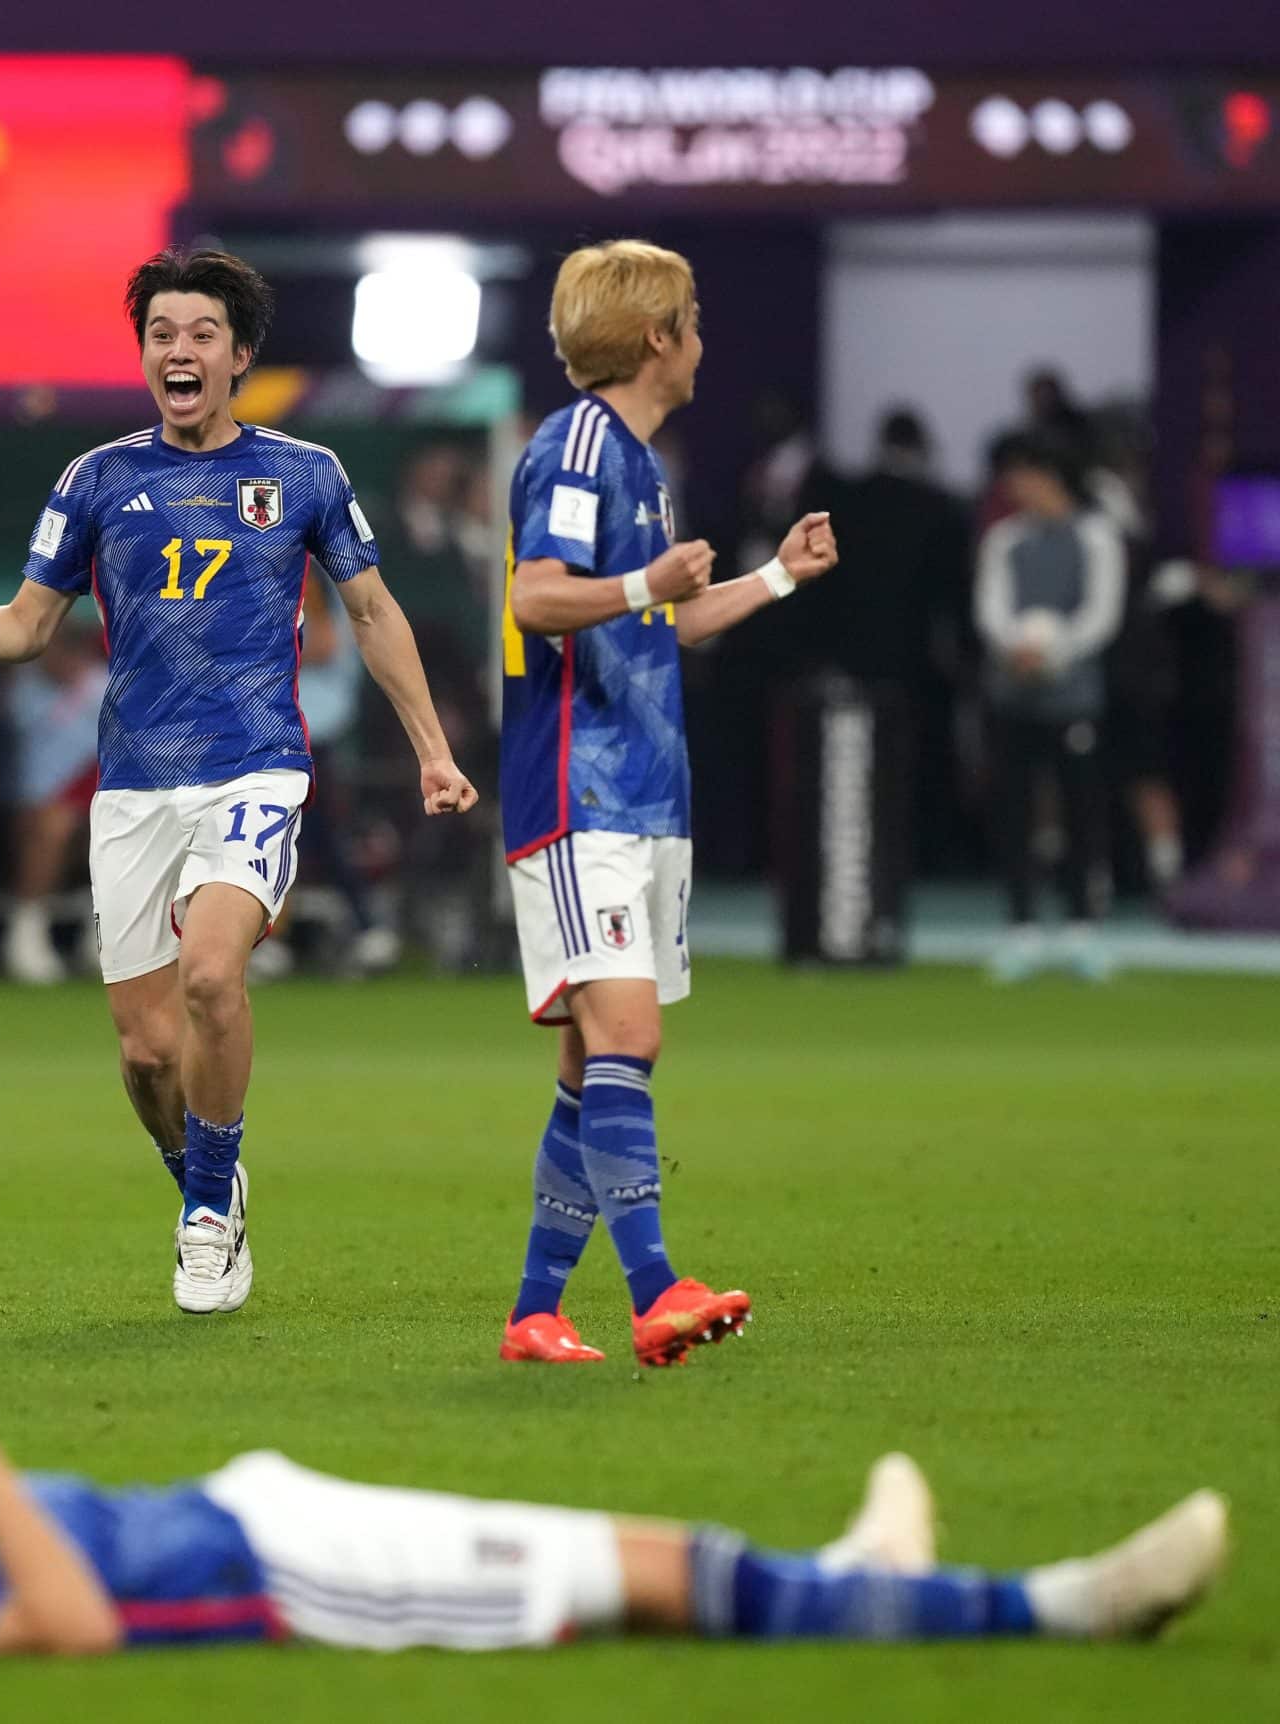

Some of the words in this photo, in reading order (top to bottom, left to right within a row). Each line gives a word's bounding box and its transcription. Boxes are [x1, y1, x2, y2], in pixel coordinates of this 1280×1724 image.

[160, 538, 233, 600] 17
[223, 801, 289, 851] 17
[539, 1195, 595, 1223] JAPA
